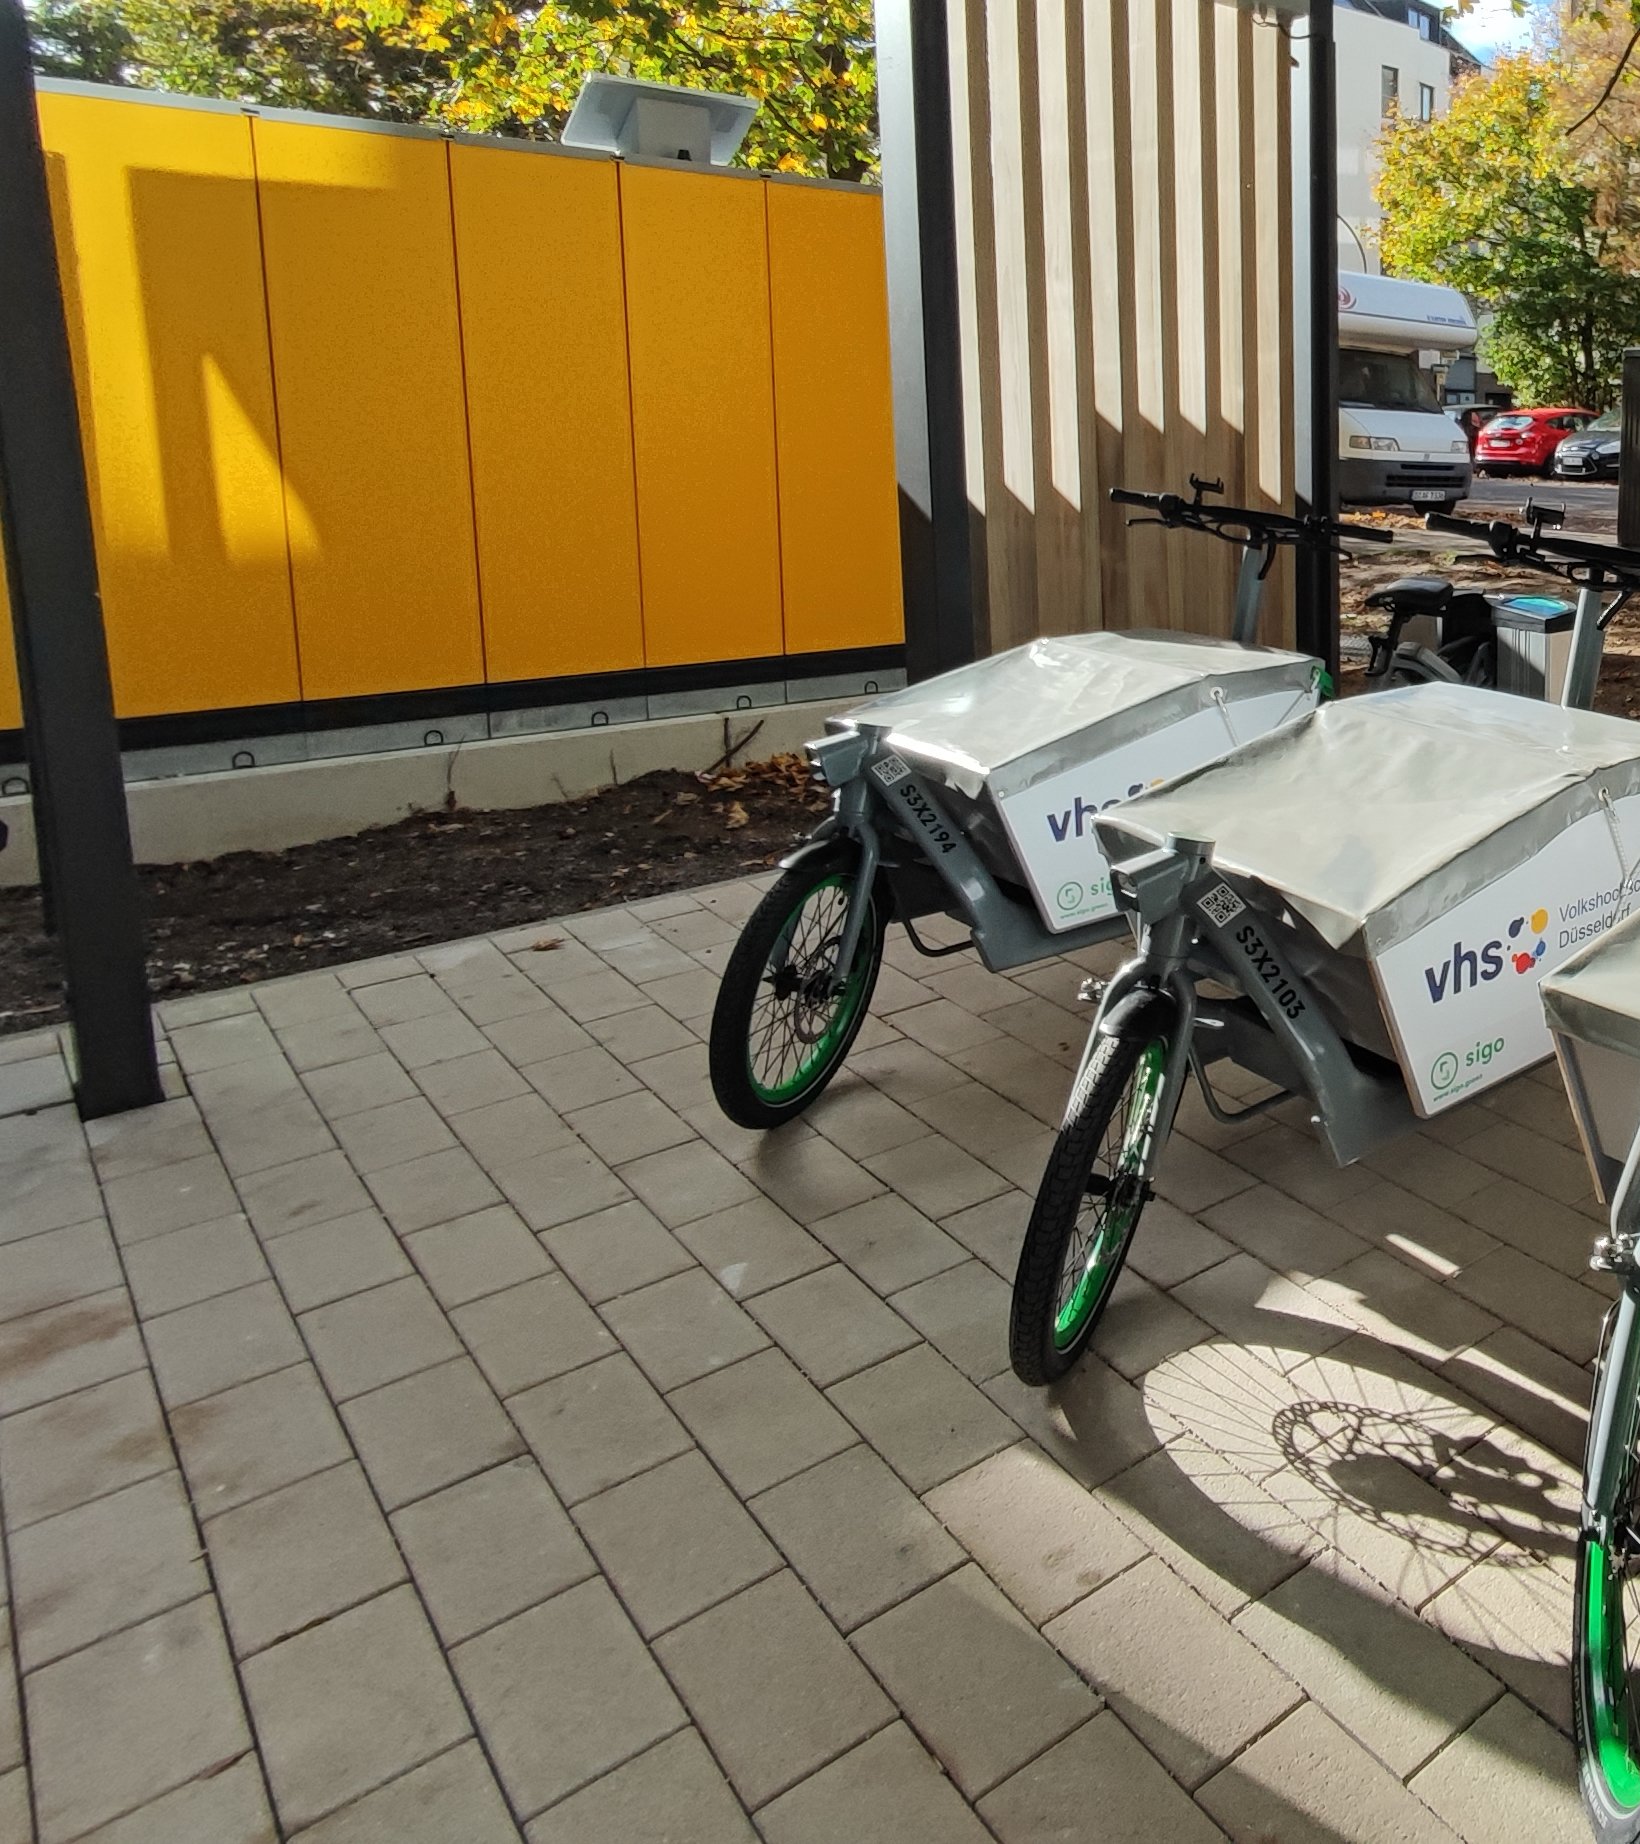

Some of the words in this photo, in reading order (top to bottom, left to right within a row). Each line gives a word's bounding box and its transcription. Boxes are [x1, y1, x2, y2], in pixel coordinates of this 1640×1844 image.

[900, 784, 957, 854] S3X2194
[1046, 796, 1121, 842] vh
[1559, 902, 1632, 949] Düsseldrf
[1236, 925, 1306, 1020] S3X2103
[1424, 940, 1504, 1004] vhs
[1465, 1037, 1505, 1067] sigo
